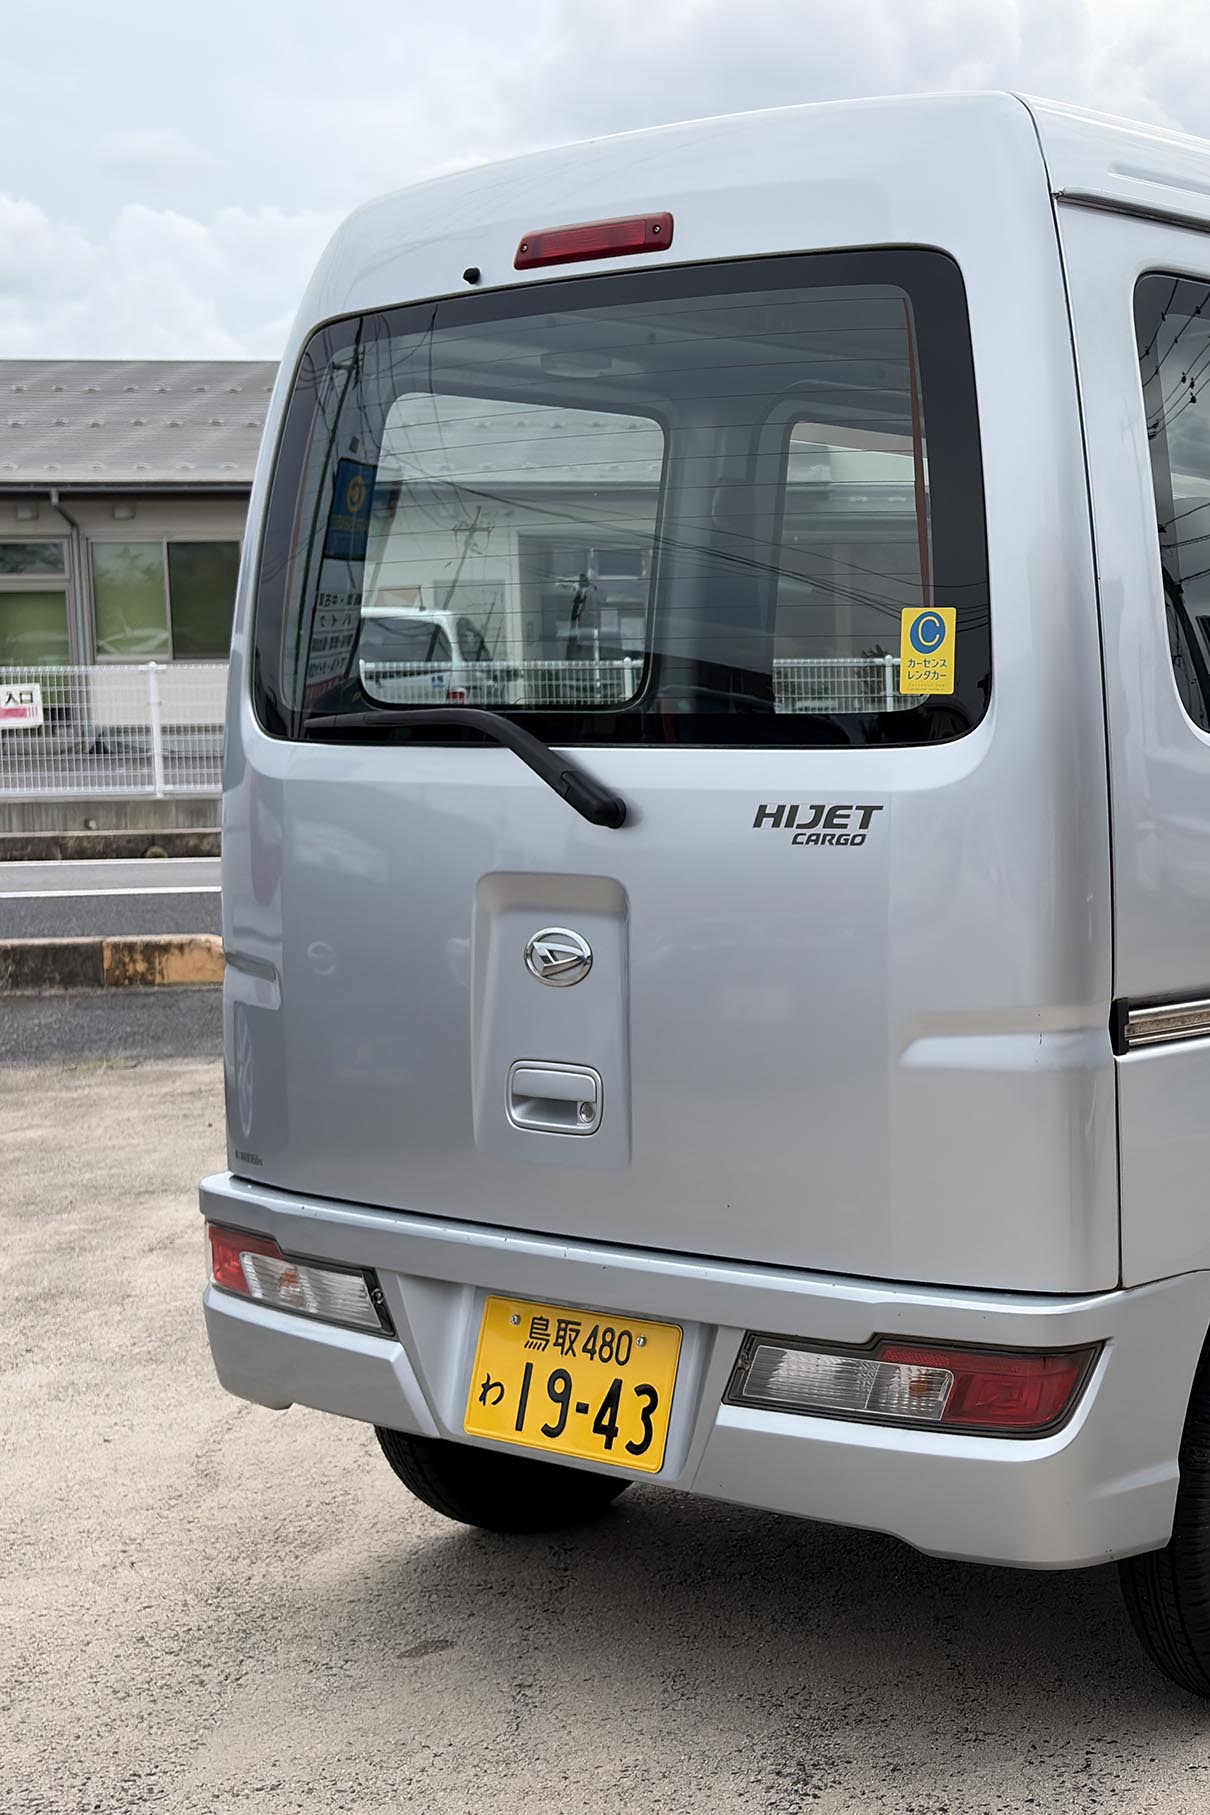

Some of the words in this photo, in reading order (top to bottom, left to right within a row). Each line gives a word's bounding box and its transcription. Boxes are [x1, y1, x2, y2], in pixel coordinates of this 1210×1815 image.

[907, 658, 947, 668] カーセンス
[907, 670, 947, 681] レンタカー
[5, 690, 34, 705] 入口
[753, 804, 884, 830] HIJET
[791, 833, 867, 846] CARGO
[478, 1373, 505, 1406] わ
[515, 1362, 659, 1456] 19-43
